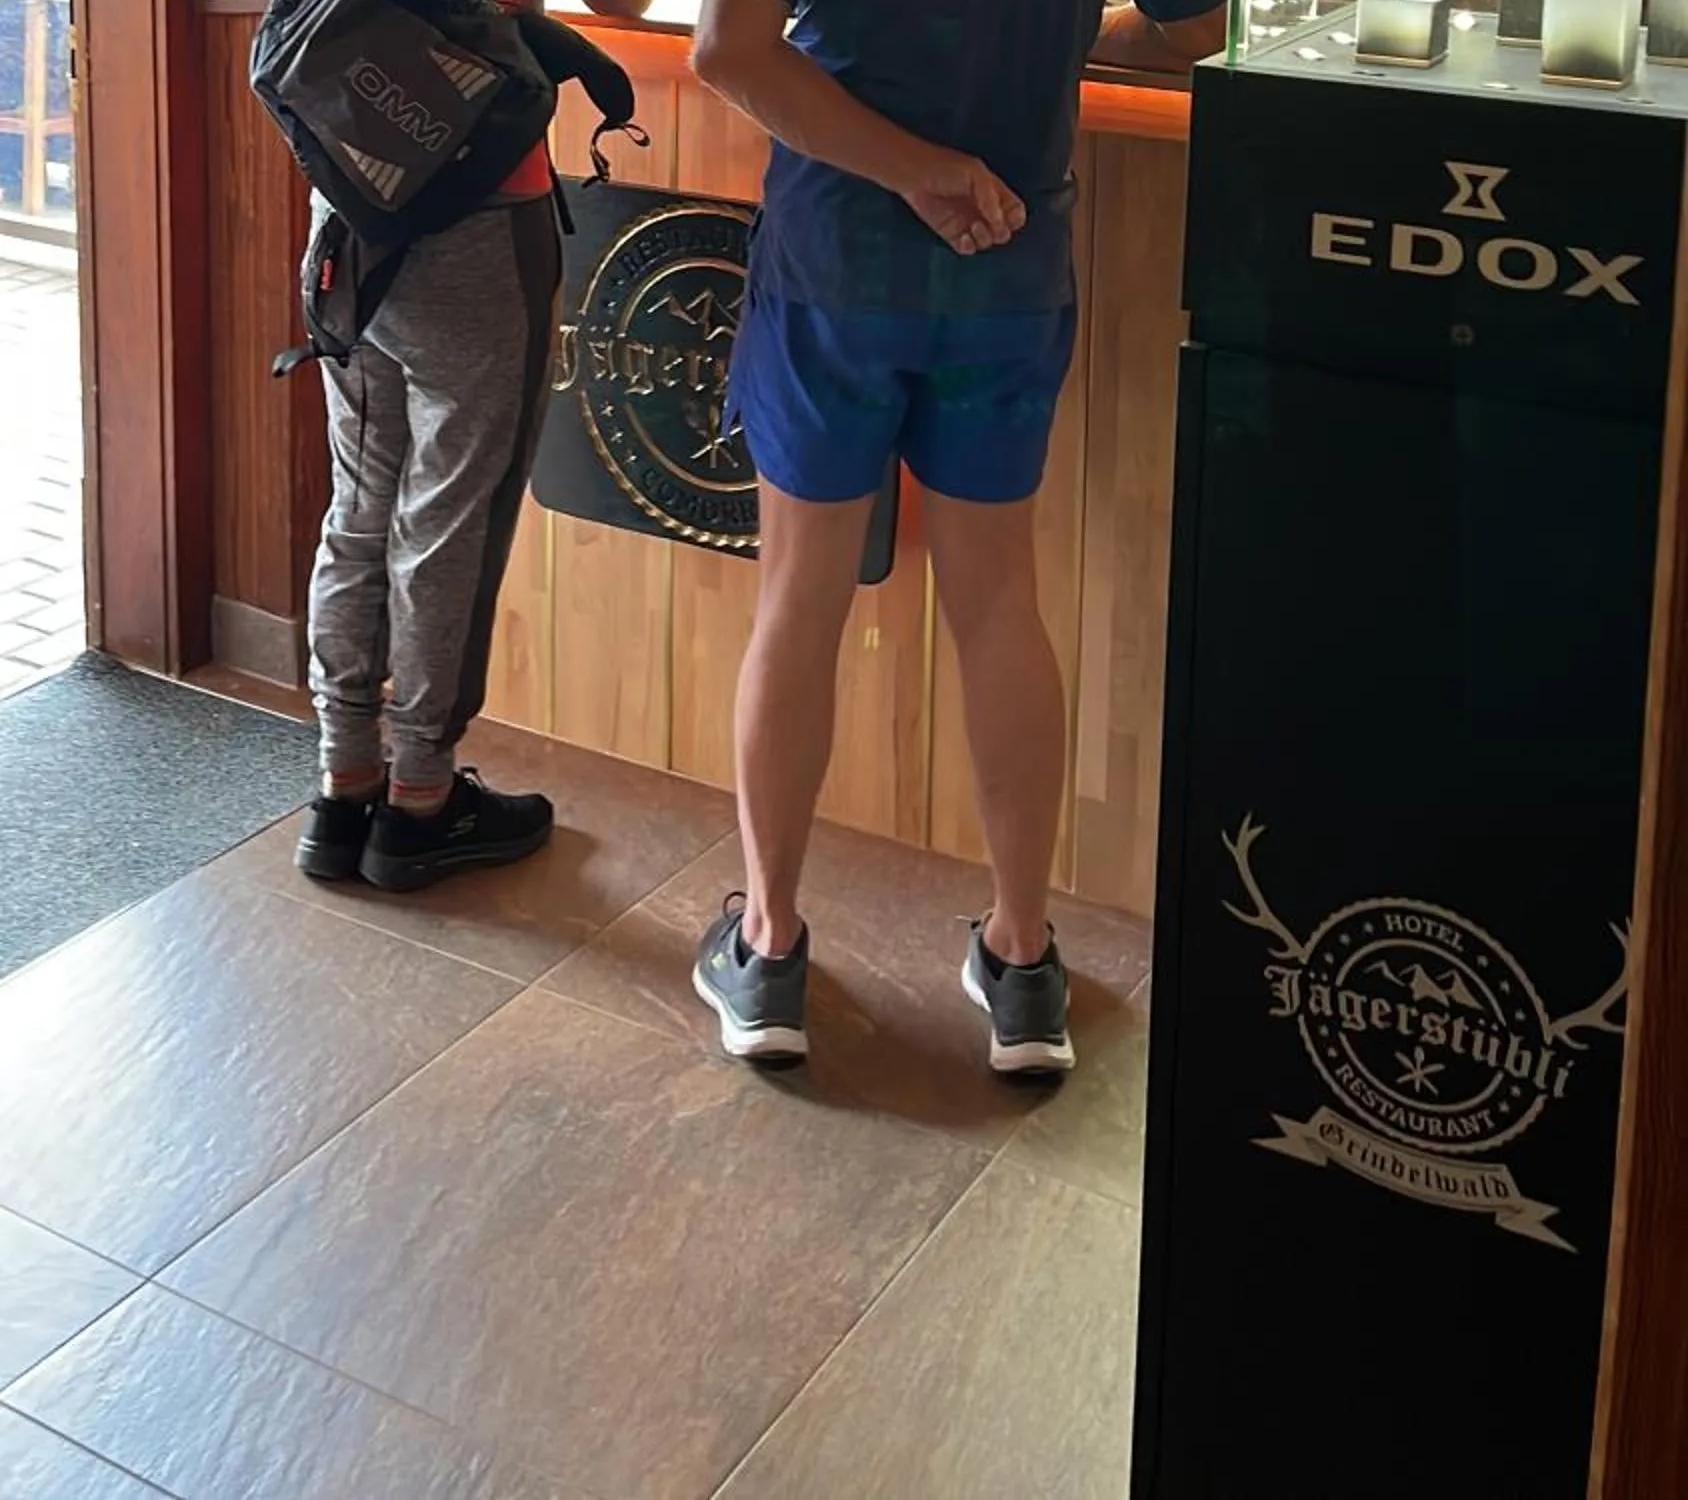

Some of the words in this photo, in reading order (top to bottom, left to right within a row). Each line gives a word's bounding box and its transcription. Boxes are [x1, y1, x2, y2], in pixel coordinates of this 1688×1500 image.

[350, 62, 451, 152] OMM
[1310, 211, 1645, 307] EDOX
[1384, 913, 1465, 953] HOTEL
[1264, 964, 1576, 1099] Jägerstübli
[1334, 1061, 1497, 1139] RESTAURANT
